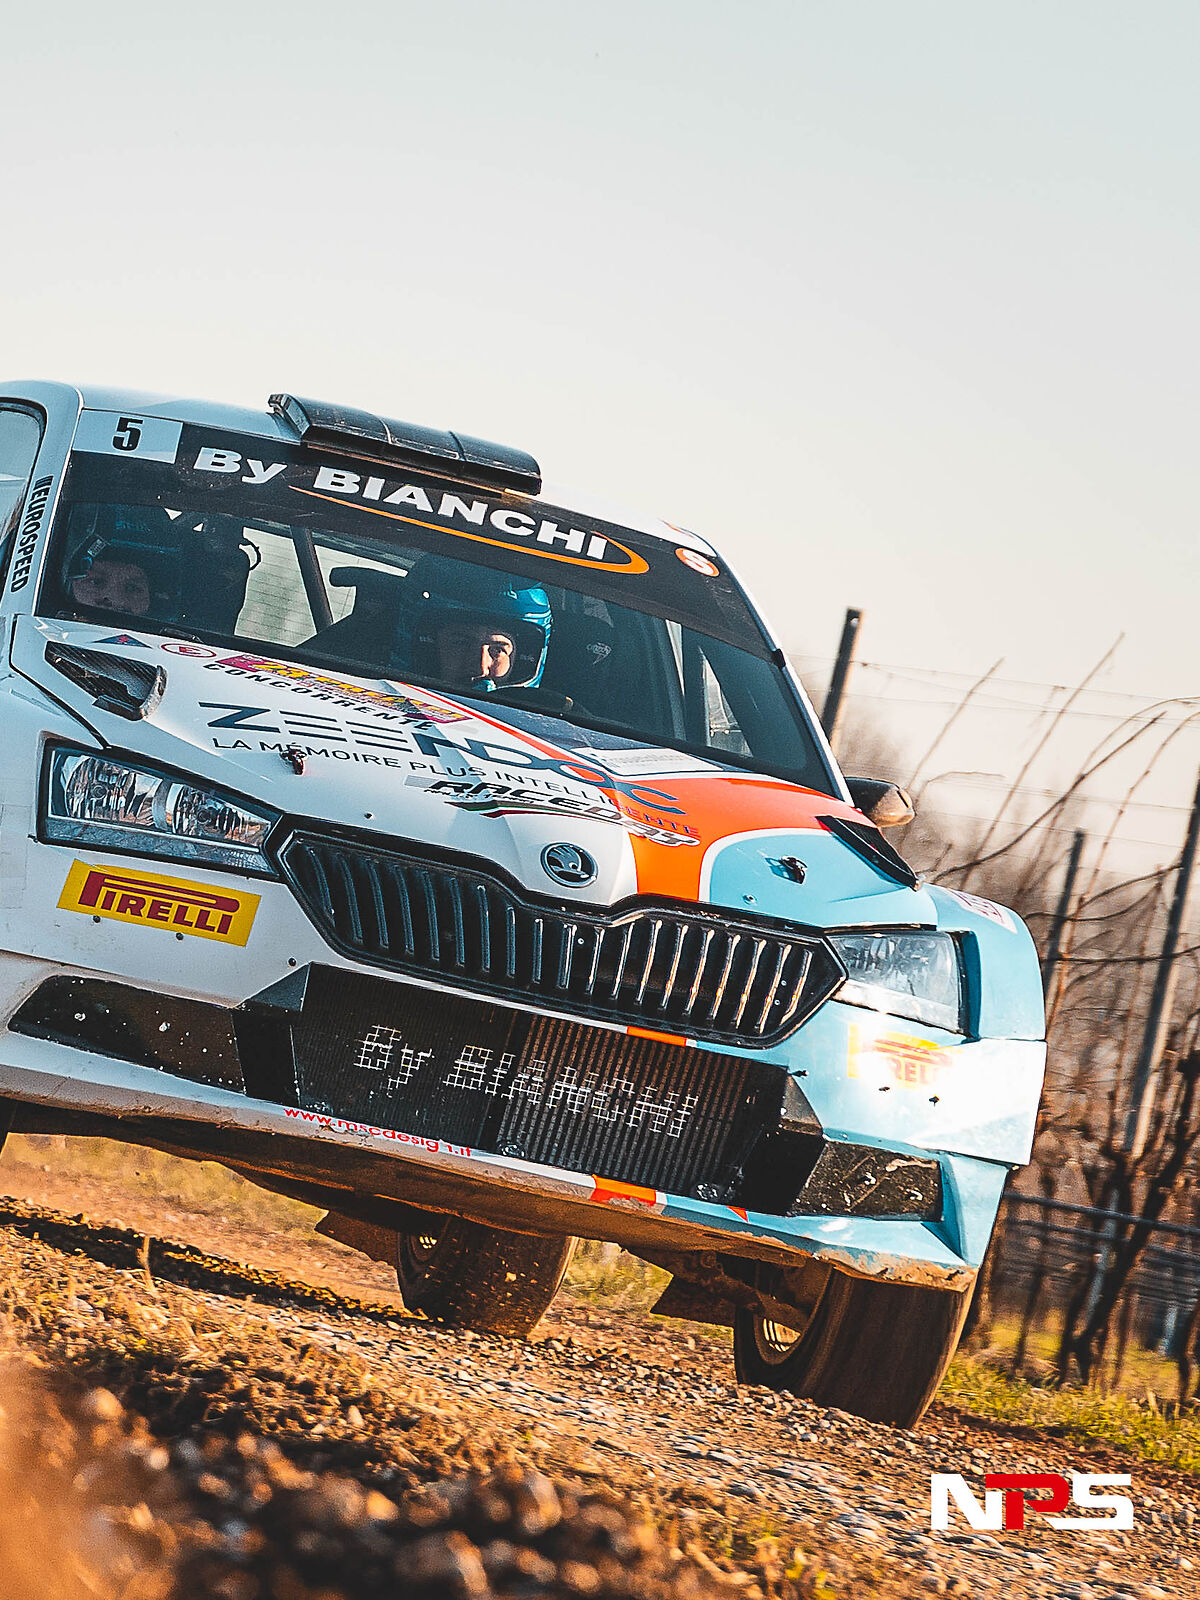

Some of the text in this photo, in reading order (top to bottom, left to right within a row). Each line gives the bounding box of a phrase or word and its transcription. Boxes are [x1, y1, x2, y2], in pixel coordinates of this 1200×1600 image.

[112, 417, 143, 451] 5
[193, 446, 608, 560] By BIANCHI
[11, 486, 50, 592] EUROSPEED
[203, 663, 436, 731] CONCORRENTE
[212, 737, 253, 751] LA
[259, 741, 402, 769] MÉMOIRE
[409, 761, 487, 777] PLUS
[78, 871, 240, 935] PIRELLI
[353, 1025, 699, 1139] By BIANCHI
